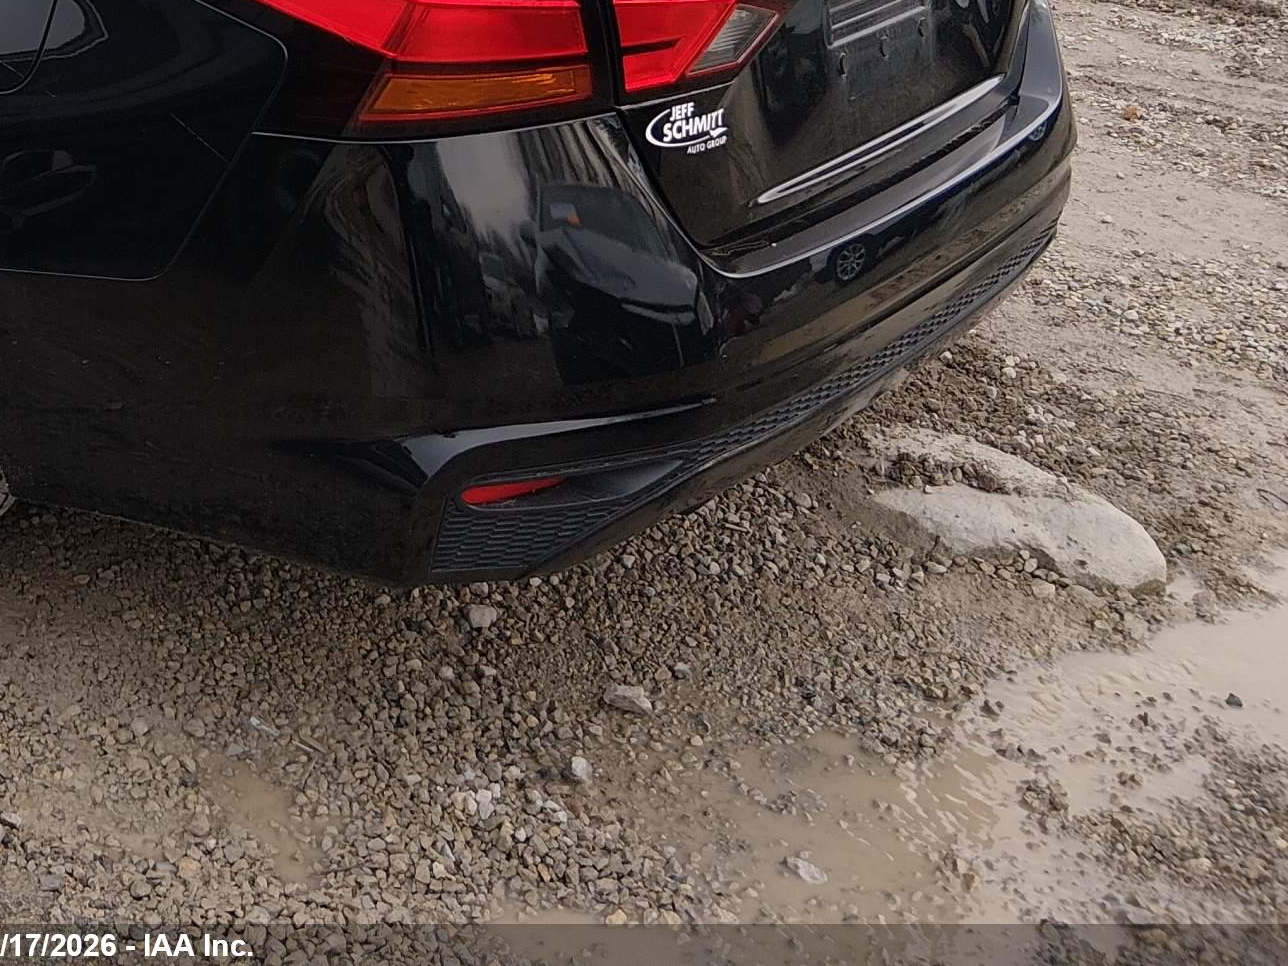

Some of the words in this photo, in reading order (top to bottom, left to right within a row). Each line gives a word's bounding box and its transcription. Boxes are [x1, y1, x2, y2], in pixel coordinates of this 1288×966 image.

[669, 101, 695, 122] JEFF
[662, 107, 724, 142] SCHMITT
[686, 143, 706, 155] AUTO
[706, 135, 727, 150] GROUP
